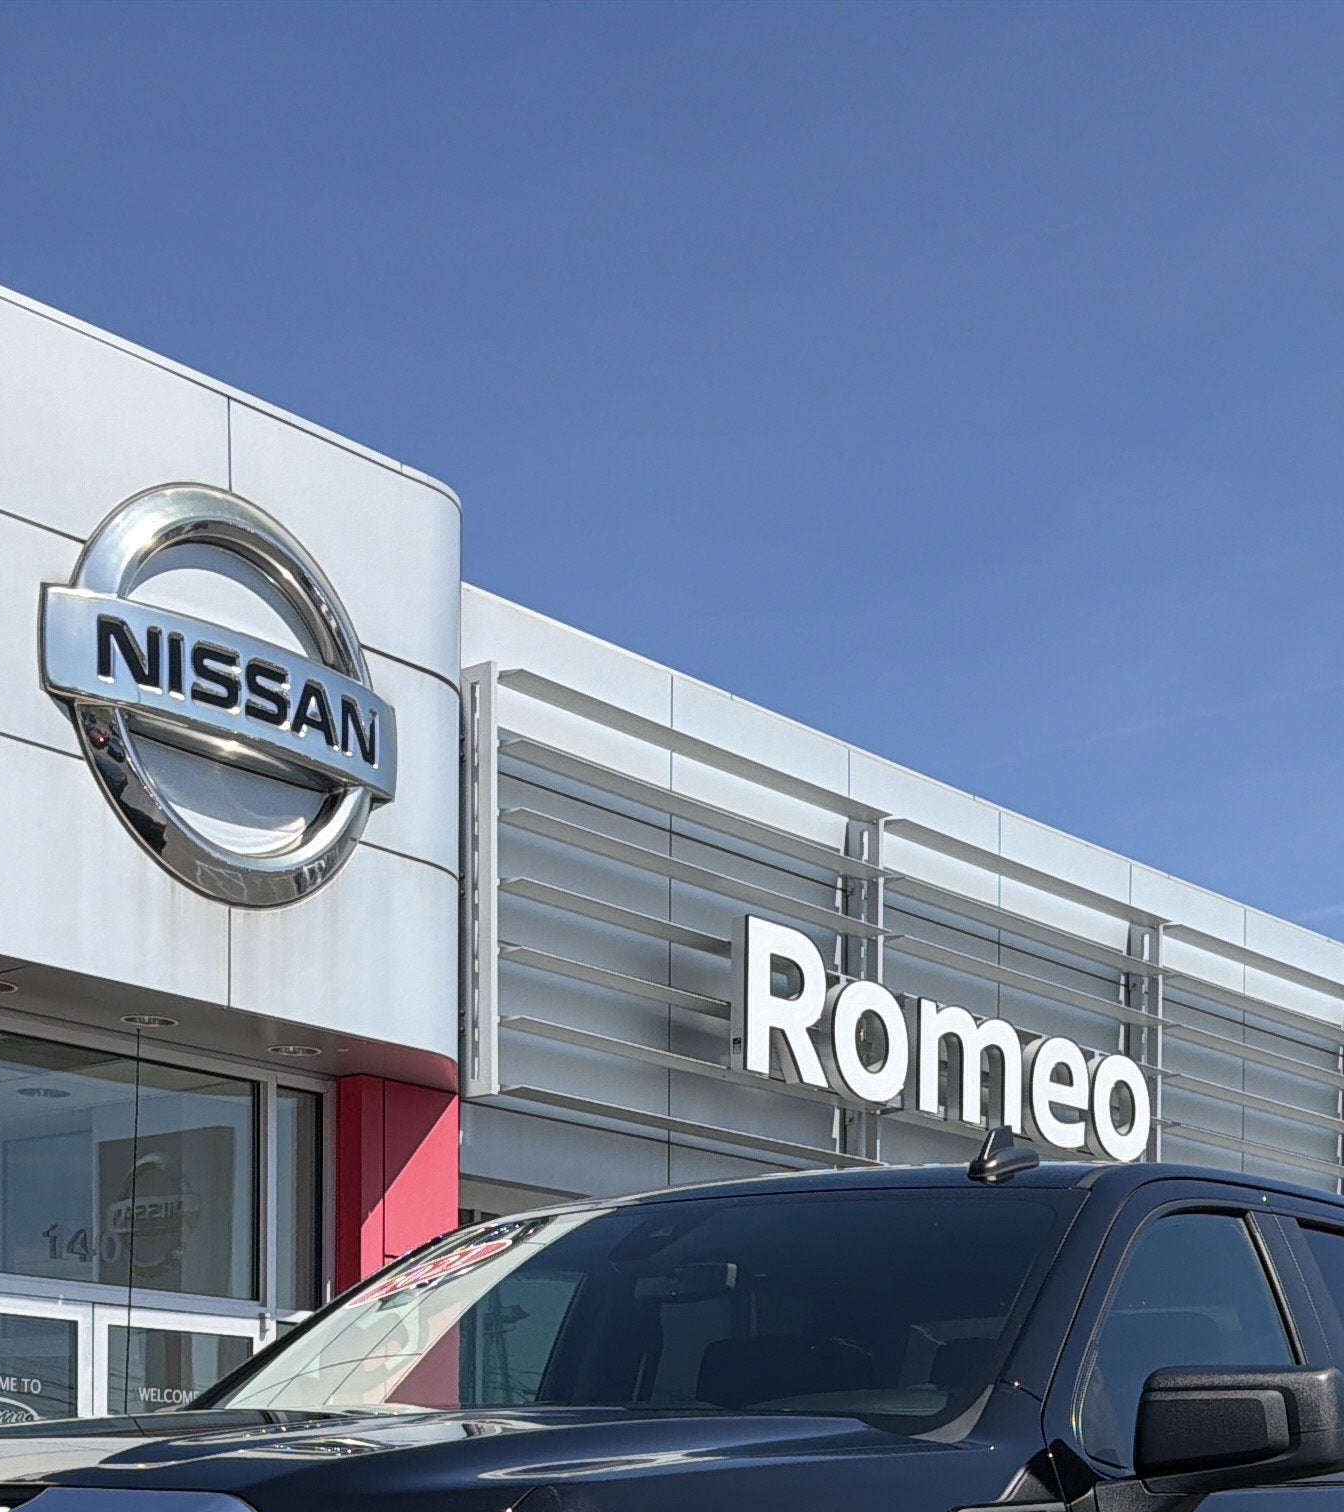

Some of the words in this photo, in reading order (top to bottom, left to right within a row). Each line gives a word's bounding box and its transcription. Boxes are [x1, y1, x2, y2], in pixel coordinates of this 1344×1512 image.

[96, 613, 381, 769] NISSAN
[740, 914, 1152, 1162] Romeo
[42, 1224, 122, 1265] 140
[21, 1378, 42, 1395] TO
